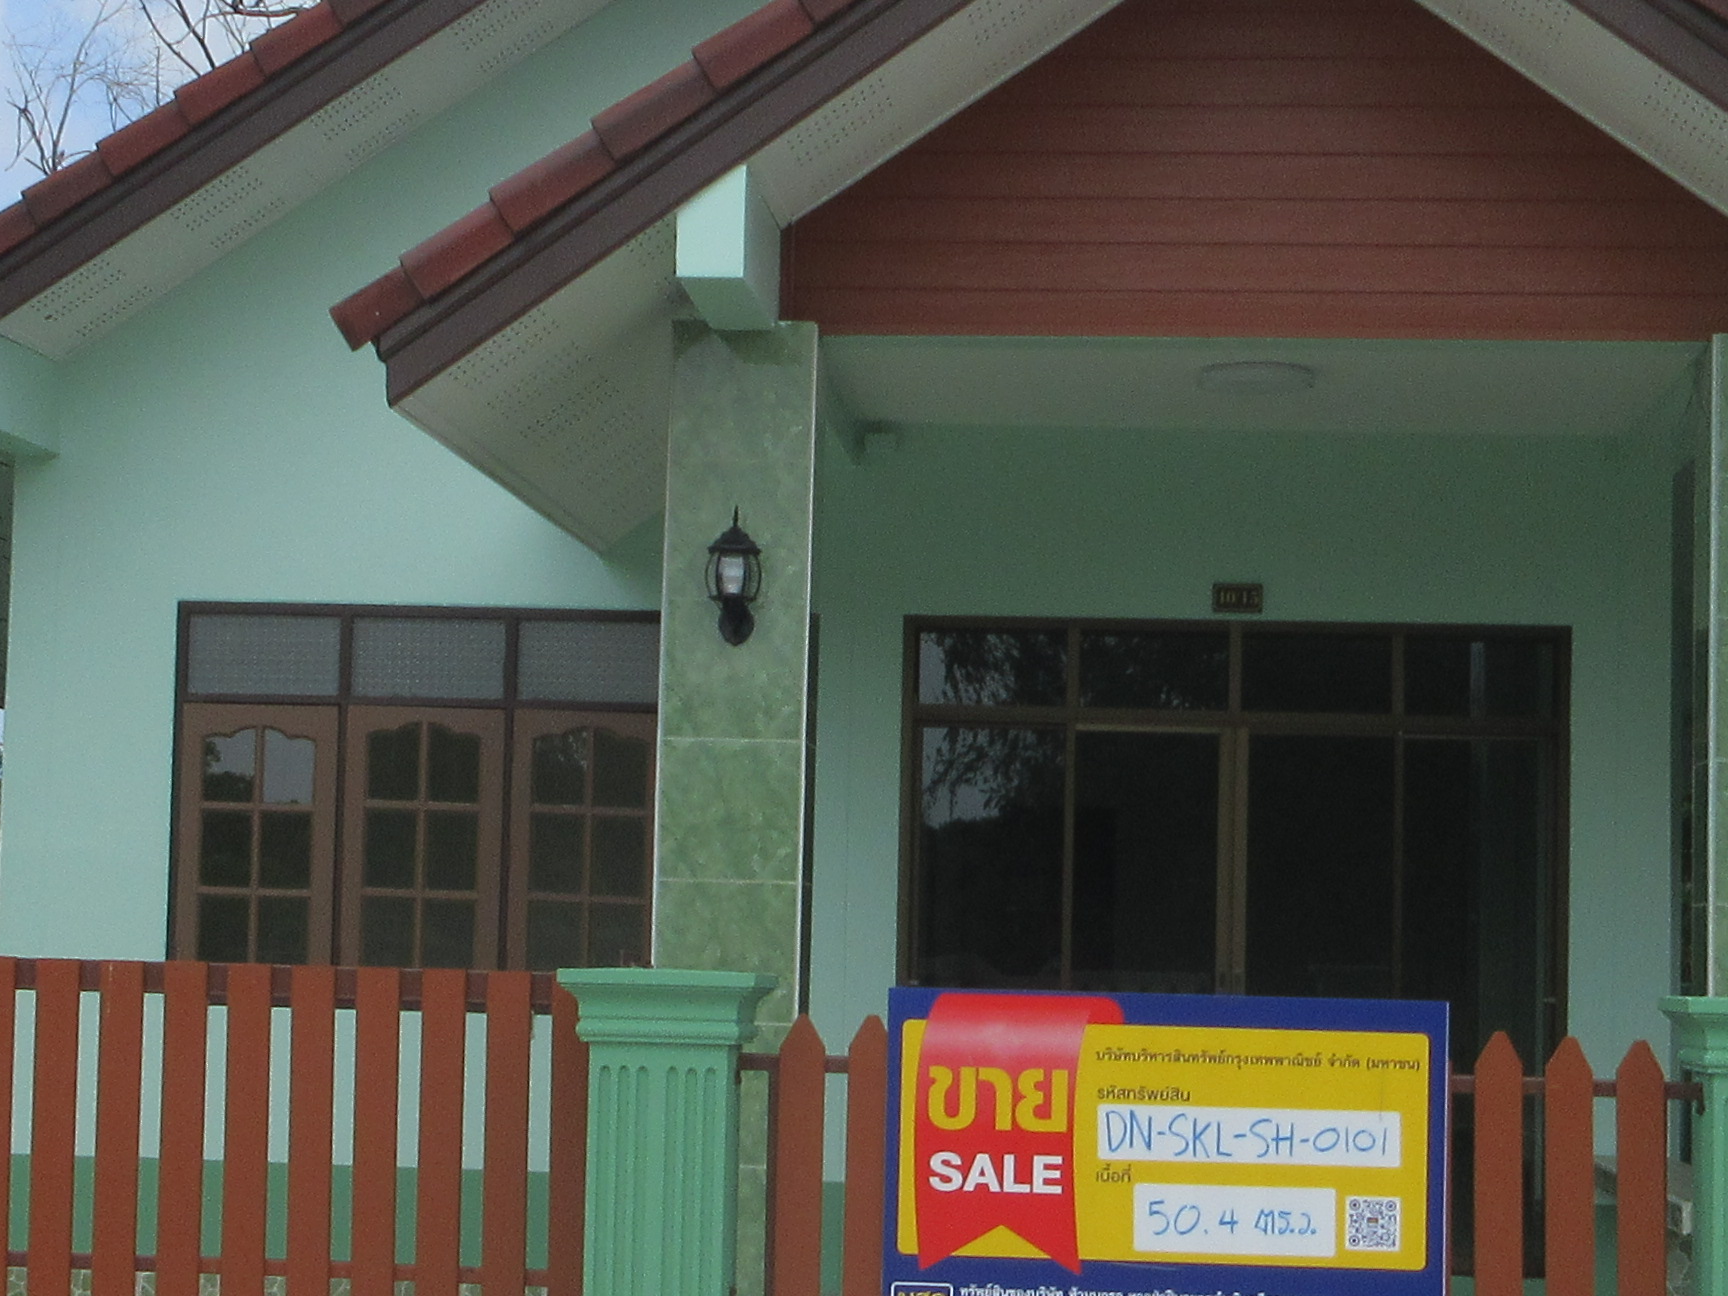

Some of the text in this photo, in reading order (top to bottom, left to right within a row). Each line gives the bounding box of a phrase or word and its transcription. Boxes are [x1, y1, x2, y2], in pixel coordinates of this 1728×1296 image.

[1327, 1053, 1360, 1069] จำกัด
[1366, 1056, 1421, 1072] (มหาชน)
[928, 1065, 1069, 1134] ขาย
[1097, 1084, 1191, 1102] รหัสทรัพย์สิน
[1105, 1109, 1388, 1158] DN-SKL-SH-0101
[928, 1151, 1064, 1195] SALE
[1095, 1162, 1132, 1183] เนื้อที่
